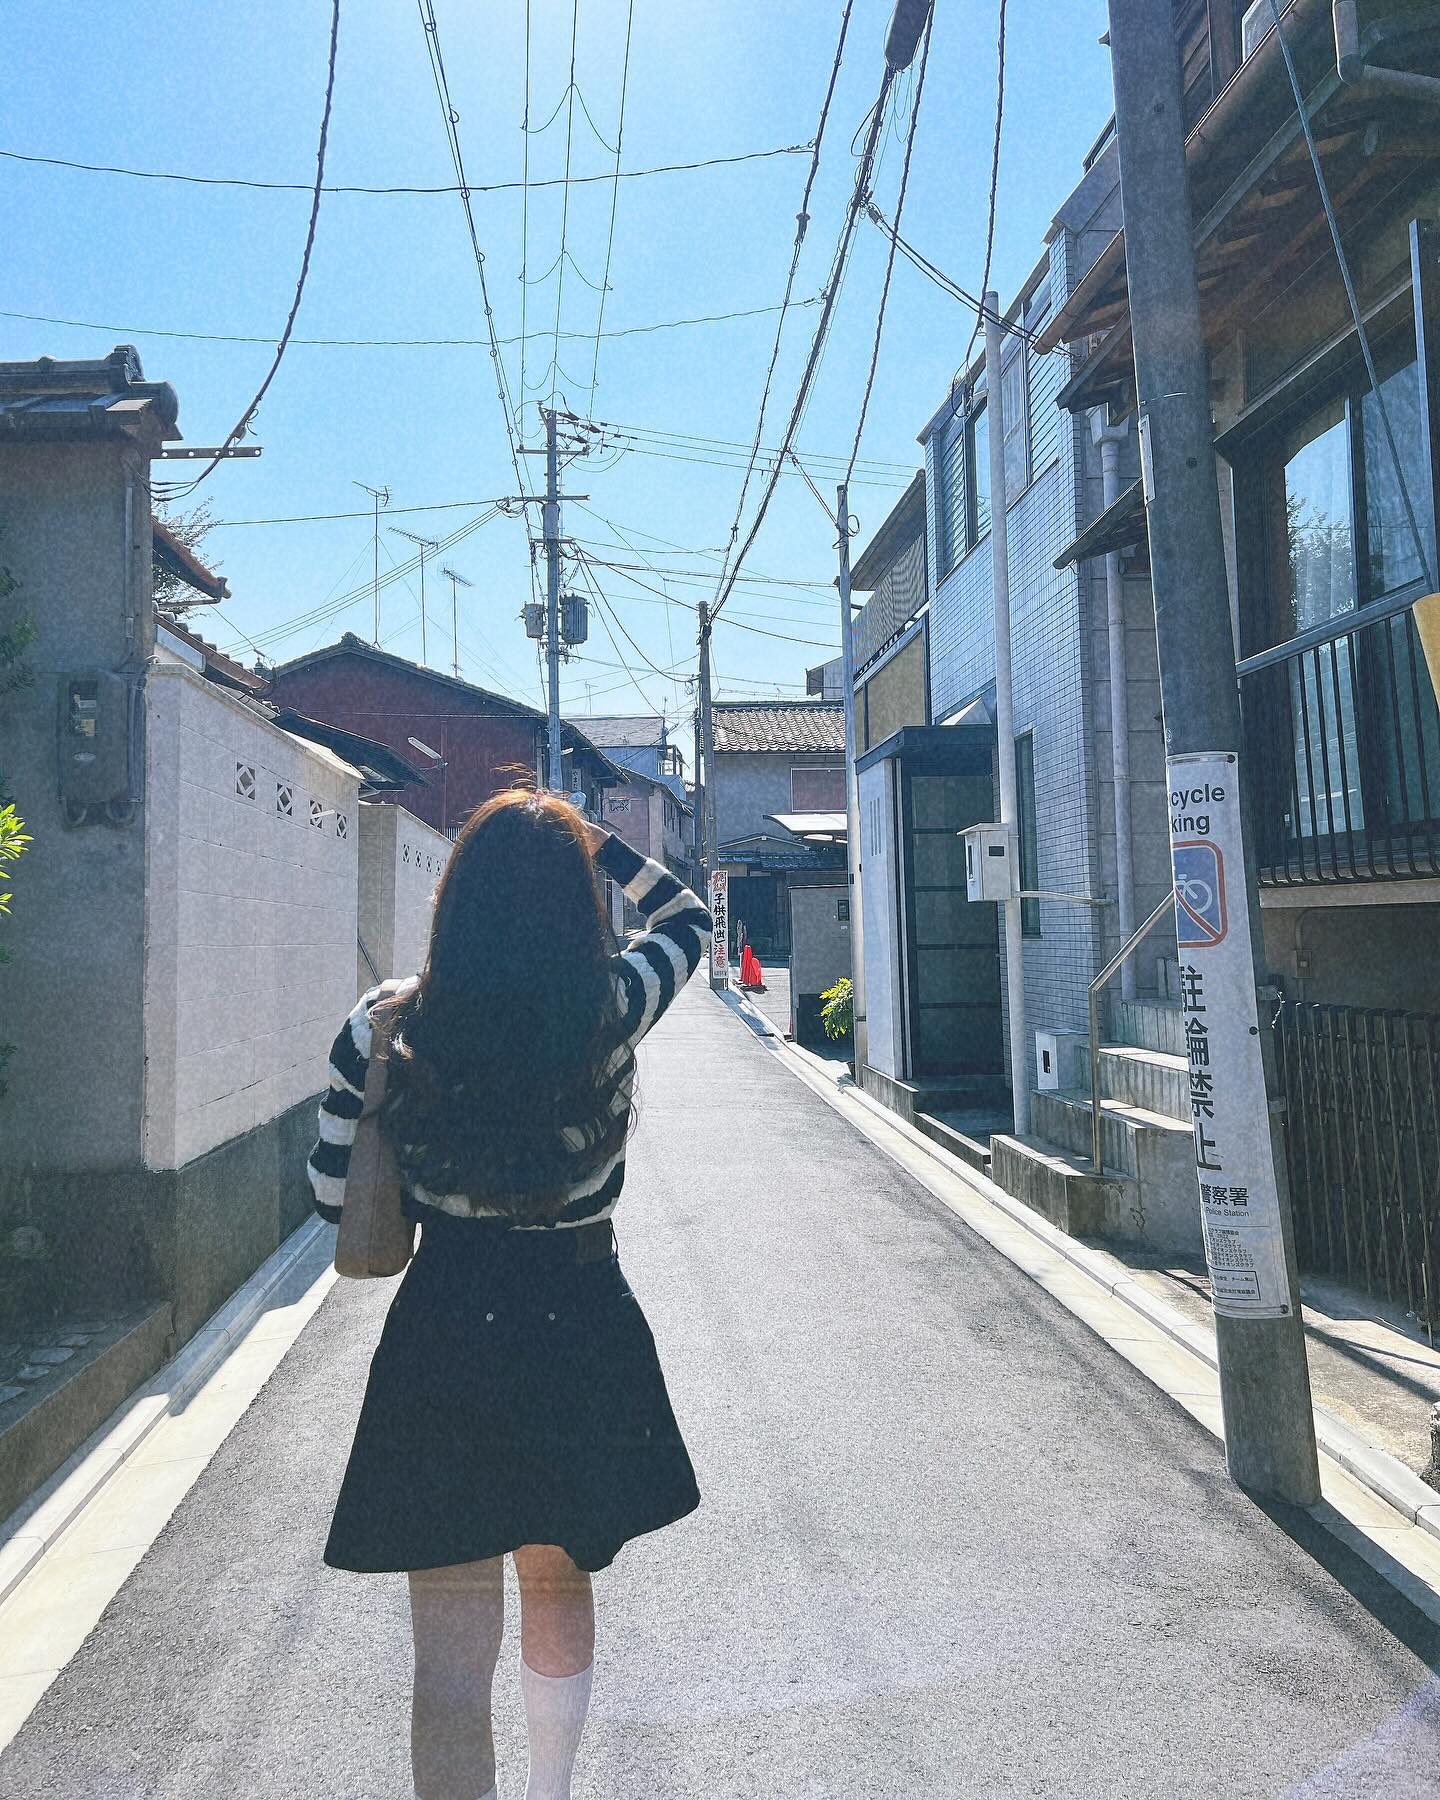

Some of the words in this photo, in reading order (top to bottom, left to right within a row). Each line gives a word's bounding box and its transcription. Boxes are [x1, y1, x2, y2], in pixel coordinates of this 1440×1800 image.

[1171, 783, 1225, 810] cycle
[1171, 813, 1210, 835] king
[1223, 1208, 1250, 1217] Station
